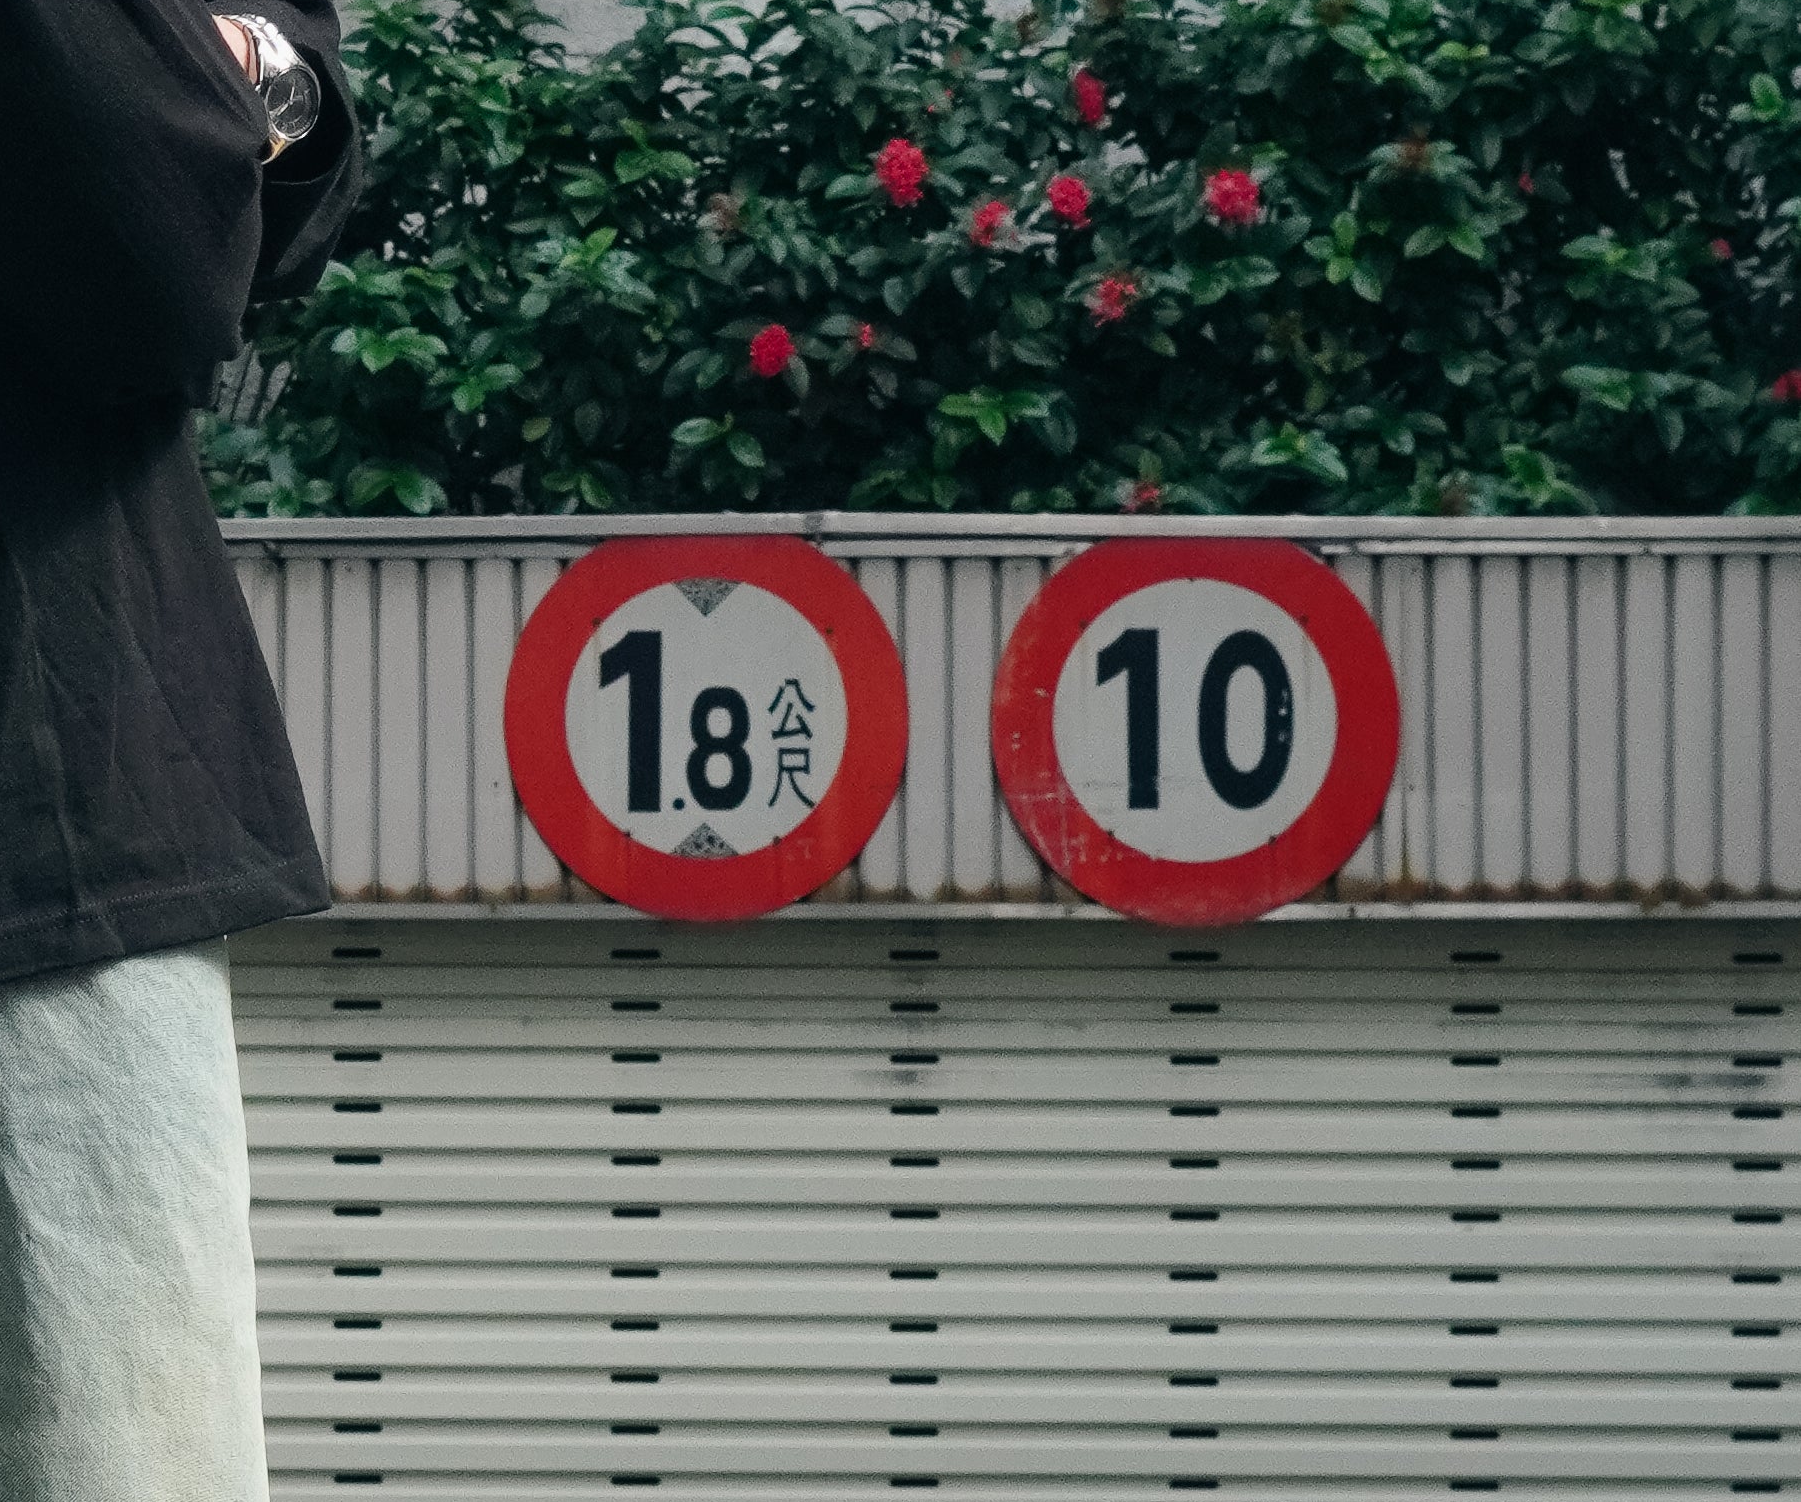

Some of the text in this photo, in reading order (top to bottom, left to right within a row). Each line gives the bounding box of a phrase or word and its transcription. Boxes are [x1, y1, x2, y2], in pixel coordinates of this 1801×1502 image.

[599, 630, 817, 814] 1.8 公尺
[1095, 627, 1296, 811] 10
